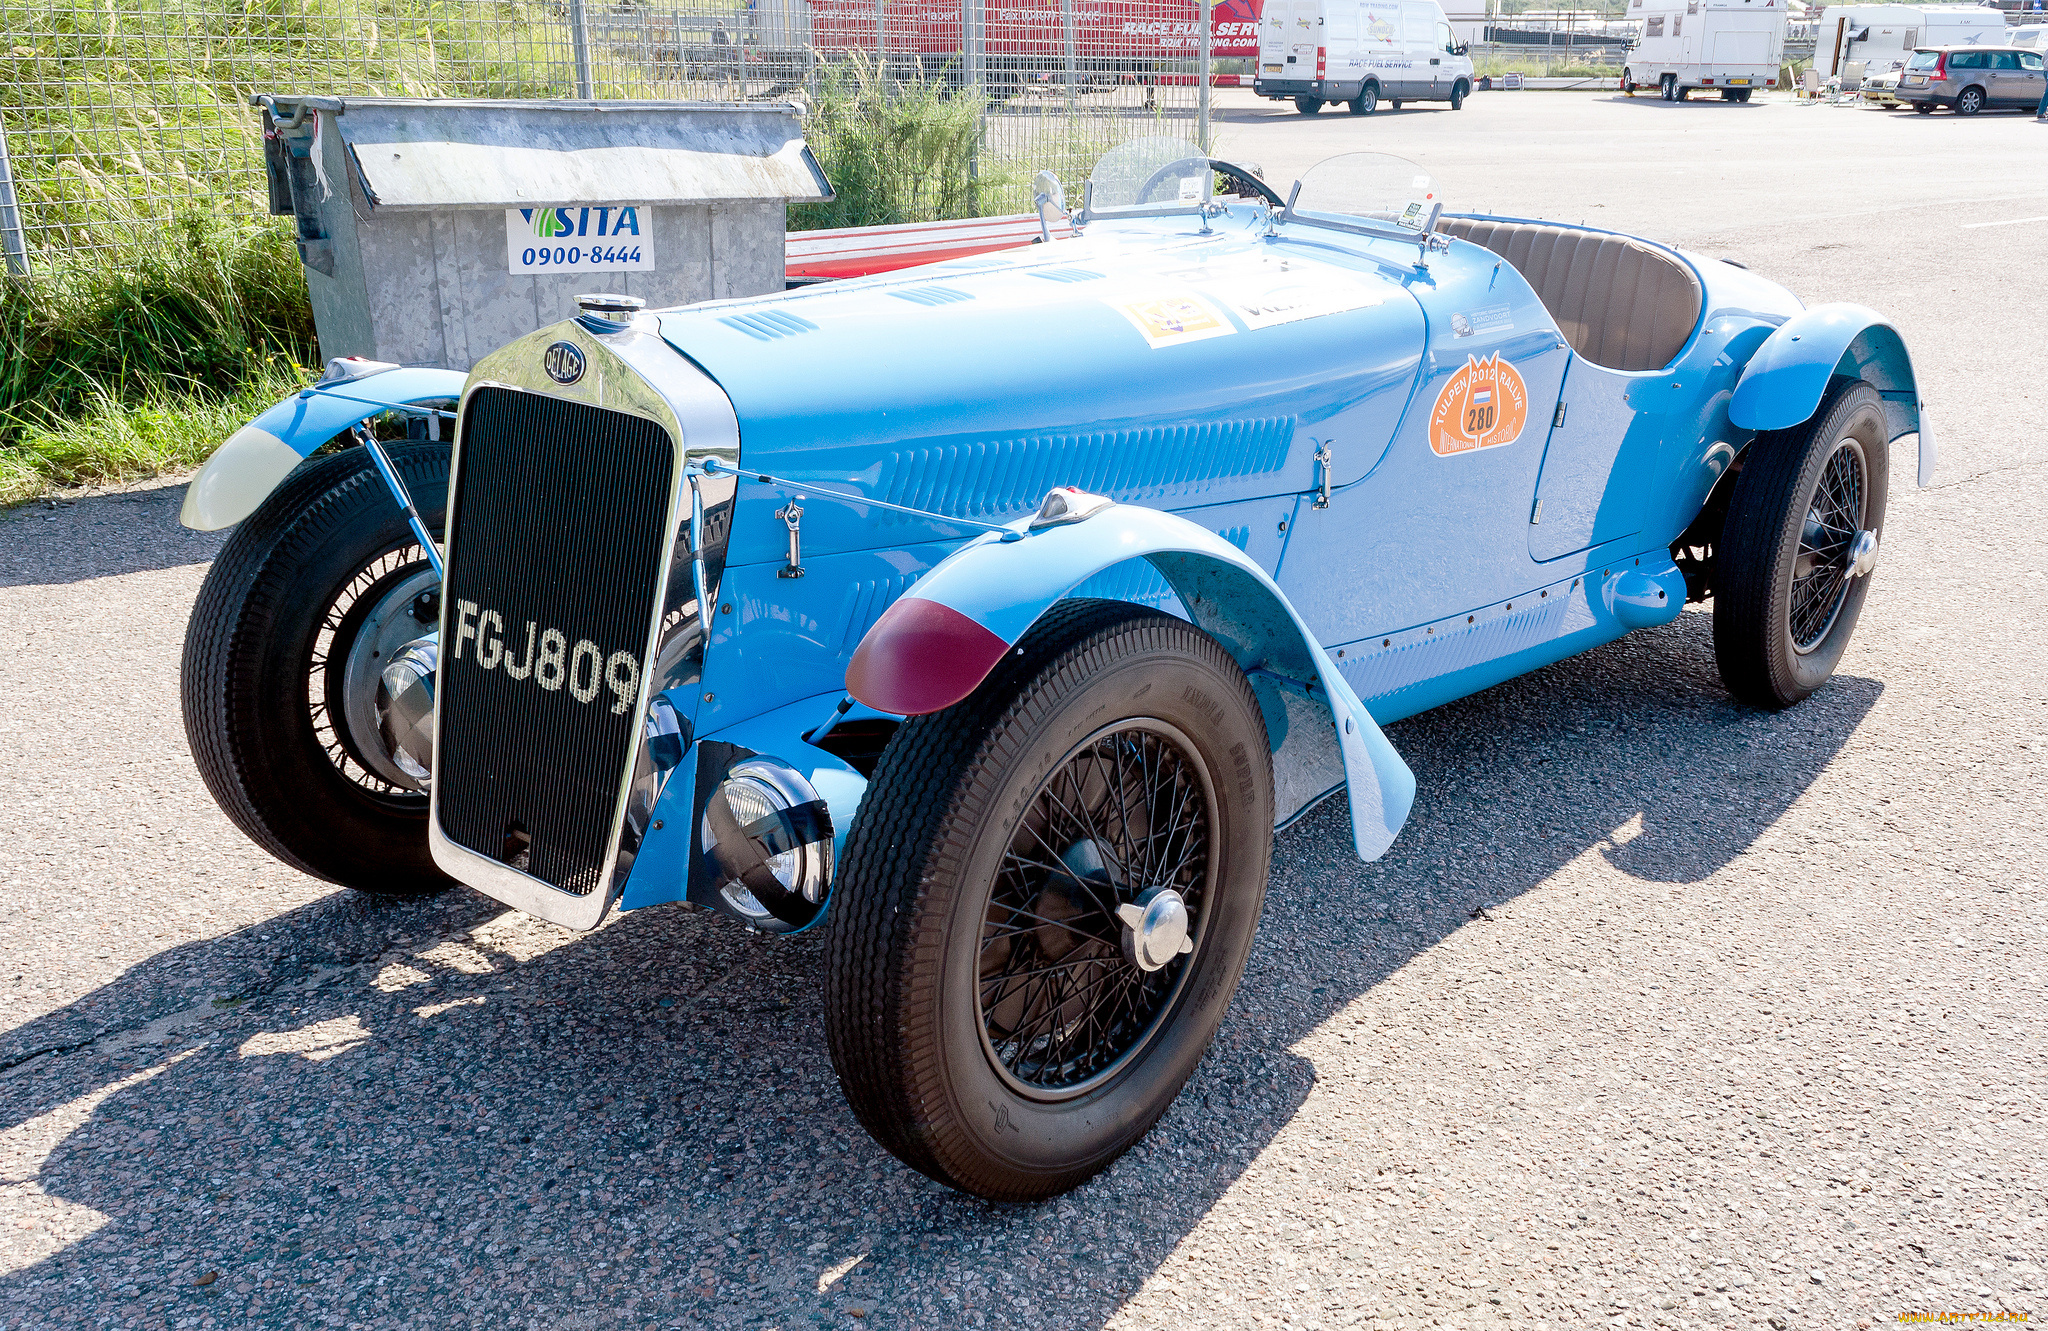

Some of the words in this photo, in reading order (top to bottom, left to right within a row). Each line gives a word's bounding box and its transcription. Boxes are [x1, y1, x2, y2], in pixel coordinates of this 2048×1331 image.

[1368, 24, 1394, 36] SUNOCO
[1348, 59, 1368, 68] RACE
[1368, 59, 1384, 68] FUEL
[1384, 59, 1413, 69] SERVICE
[554, 206, 640, 238] SITA
[522, 246, 641, 266] 0900-8444
[1471, 311, 1511, 324] ZANDVOORT
[546, 347, 580, 379] DELAGE
[1471, 367, 1496, 384] 2012
[1436, 376, 1467, 426] TULPEN
[1499, 371, 1523, 411] RALLYE
[1468, 405, 1494, 432] 280
[1487, 417, 1517, 444] HISTORIC
[1438, 427, 1475, 453] INTERNATIONAL
[455, 598, 640, 715] FGJ809
